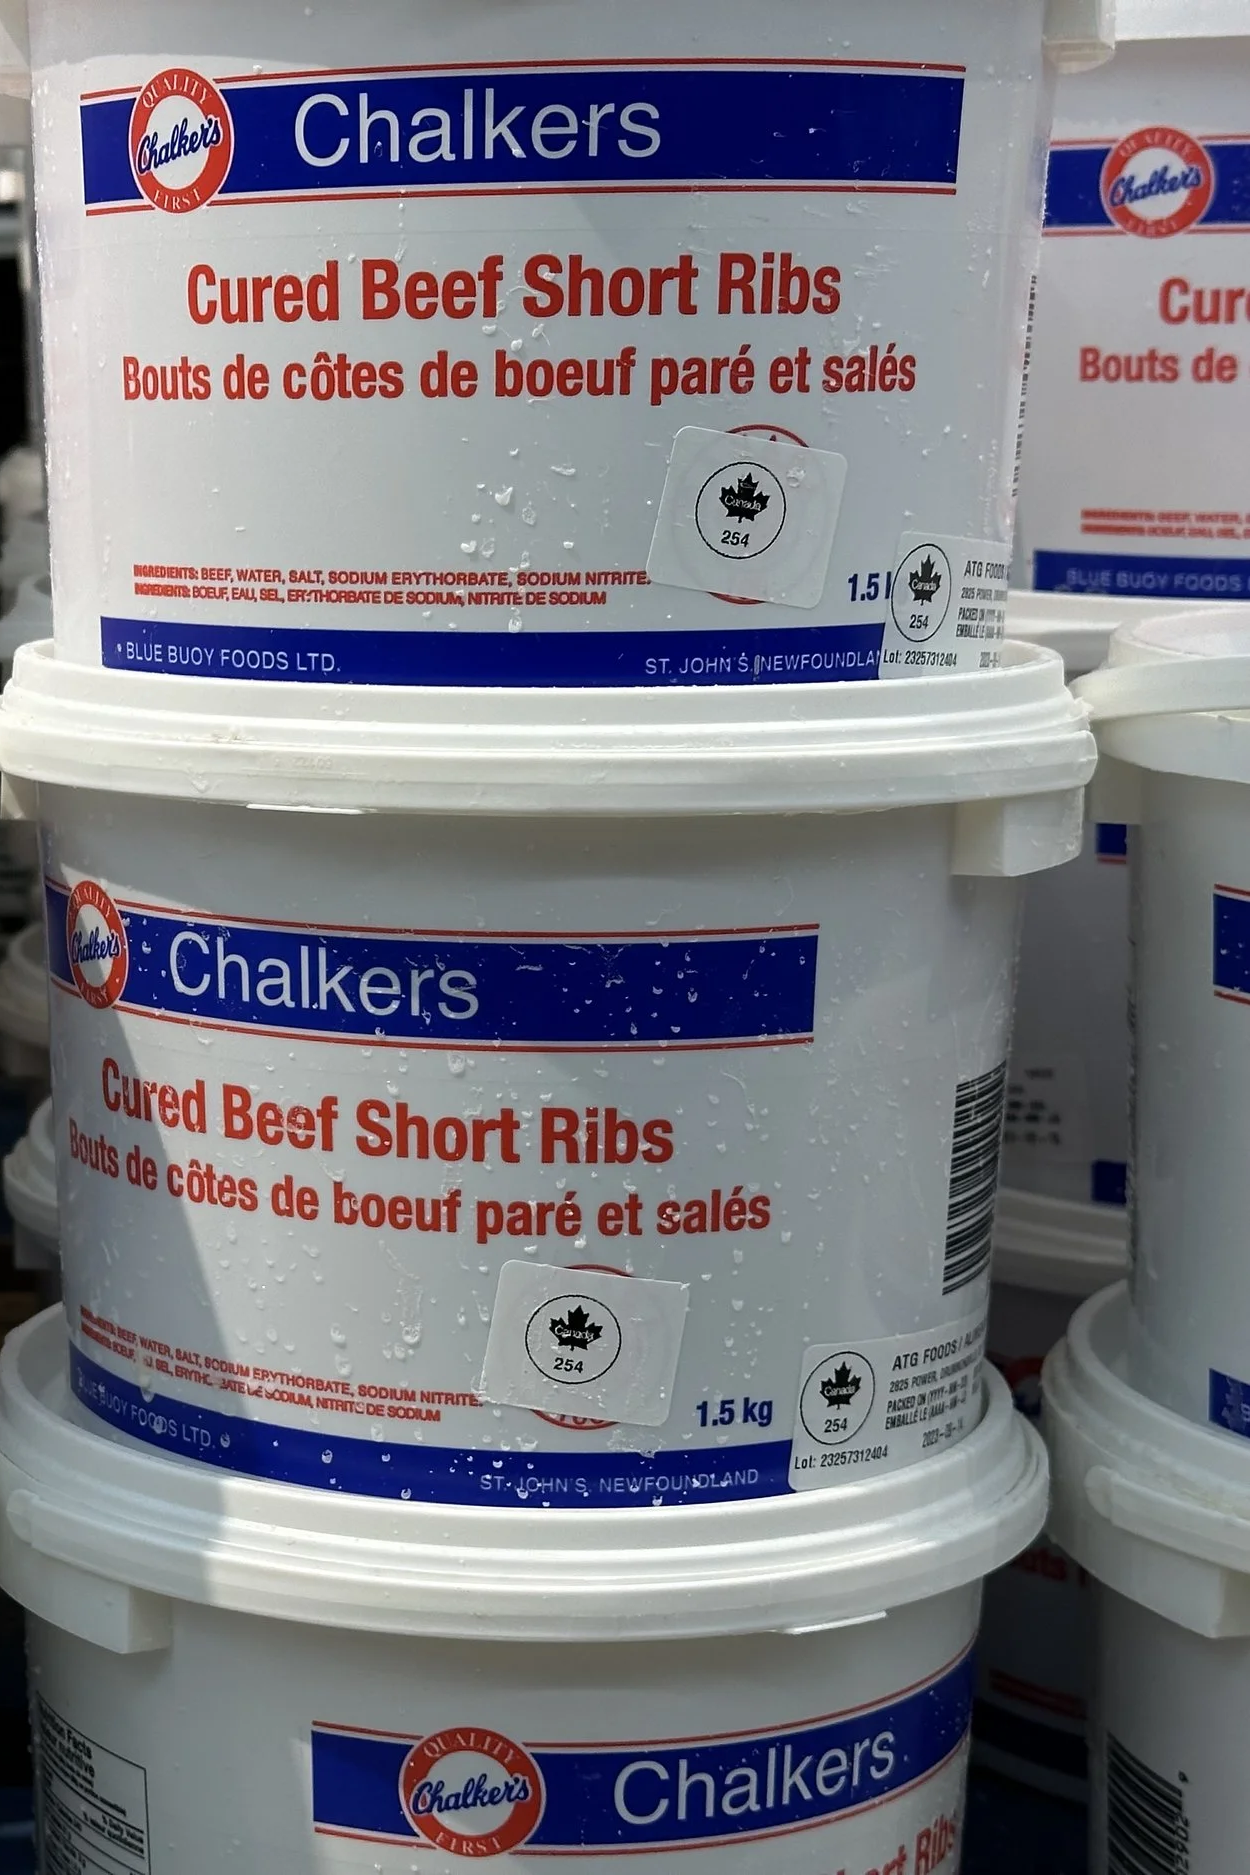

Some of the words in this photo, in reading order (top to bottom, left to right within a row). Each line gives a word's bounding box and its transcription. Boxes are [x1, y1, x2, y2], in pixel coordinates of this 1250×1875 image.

[142, 74, 213, 108] QUALITY
[294, 91, 662, 168] Chalkers
[138, 117, 221, 174] Chalker's
[154, 189, 201, 210] FIRST
[188, 260, 340, 327] Cured
[362, 256, 504, 321] Beef
[522, 253, 698, 318] Short
[717, 252, 841, 315] Ribs
[124, 354, 210, 401] Bouts
[222, 354, 268, 401] de
[284, 349, 405, 401] côtes
[419, 349, 477, 398] de
[494, 346, 636, 397] boeuf
[651, 345, 753, 407] paré
[768, 352, 811, 395] et
[823, 344, 917, 393] salés
[1079, 346, 1180, 383] Bouts
[1191, 346, 1239, 384] de
[720, 530, 750, 548] 254
[201, 567, 234, 582] BEEF,
[236, 569, 285, 585] WATER,
[289, 570, 325, 585] SALT,
[329, 571, 387, 585] SODIUM
[391, 571, 513, 587] ERYTHORBATE,
[516, 572, 581, 586] SODIUM
[964, 560, 982, 578] ATG
[1174, 573, 1243, 592] FOODS
[232, 588, 257, 602] EAU,
[259, 589, 285, 603] SEL,
[384, 591, 403, 605] DE
[406, 592, 464, 607] SODIUM,
[467, 592, 523, 606] NITRITE
[525, 592, 546, 606] DE
[549, 591, 606, 606] SODIUM
[848, 573, 880, 601] 1.5
[910, 614, 929, 629] 254
[126, 642, 163, 662] BLUE
[167, 645, 214, 666] BUOY
[220, 649, 289, 670] FOODS
[296, 652, 341, 672] LTD.
[645, 658, 672, 675] ST.
[883, 649, 902, 664] Lot:
[72, 926, 120, 963] Chalker's
[169, 931, 479, 1020] Chalkers
[102, 1058, 206, 1135] Cured
[224, 1084, 338, 1153] Beef
[356, 1099, 519, 1165] Short
[541, 1107, 674, 1165] Ribs
[69, 1117, 119, 1181] Bouts
[125, 1144, 158, 1191] de
[167, 1156, 258, 1211] côtes
[272, 1174, 320, 1221] de
[333, 1181, 461, 1234] boeuf
[476, 1190, 580, 1244] paré
[597, 1192, 643, 1236] et
[656, 1184, 771, 1236] salés
[139, 1335, 174, 1359] WATER,
[176, 1348, 202, 1367] SALT,
[204, 1356, 250, 1377] SODIUM
[358, 1384, 416, 1401] SODIUM
[553, 1357, 584, 1374] 254
[892, 1352, 918, 1371] ATG
[923, 1339, 957, 1364] FOODS
[889, 1380, 909, 1393] 2825
[366, 1403, 385, 1417] DE
[387, 1406, 441, 1422] SODIUM
[696, 1399, 735, 1427] 1.5
[742, 1398, 773, 1427] kg
[824, 1418, 848, 1433] 254
[795, 1455, 816, 1469] Lot:
[820, 1445, 888, 1467] 23257312404
[480, 1475, 507, 1492] ST.
[599, 1468, 759, 1492] NEWFOUNDLAND
[424, 1732, 520, 1764] QUALITY
[614, 1730, 895, 1825] Chalkers
[412, 1773, 529, 1814] Chalker's
[436, 1831, 500, 1855] FIRST
